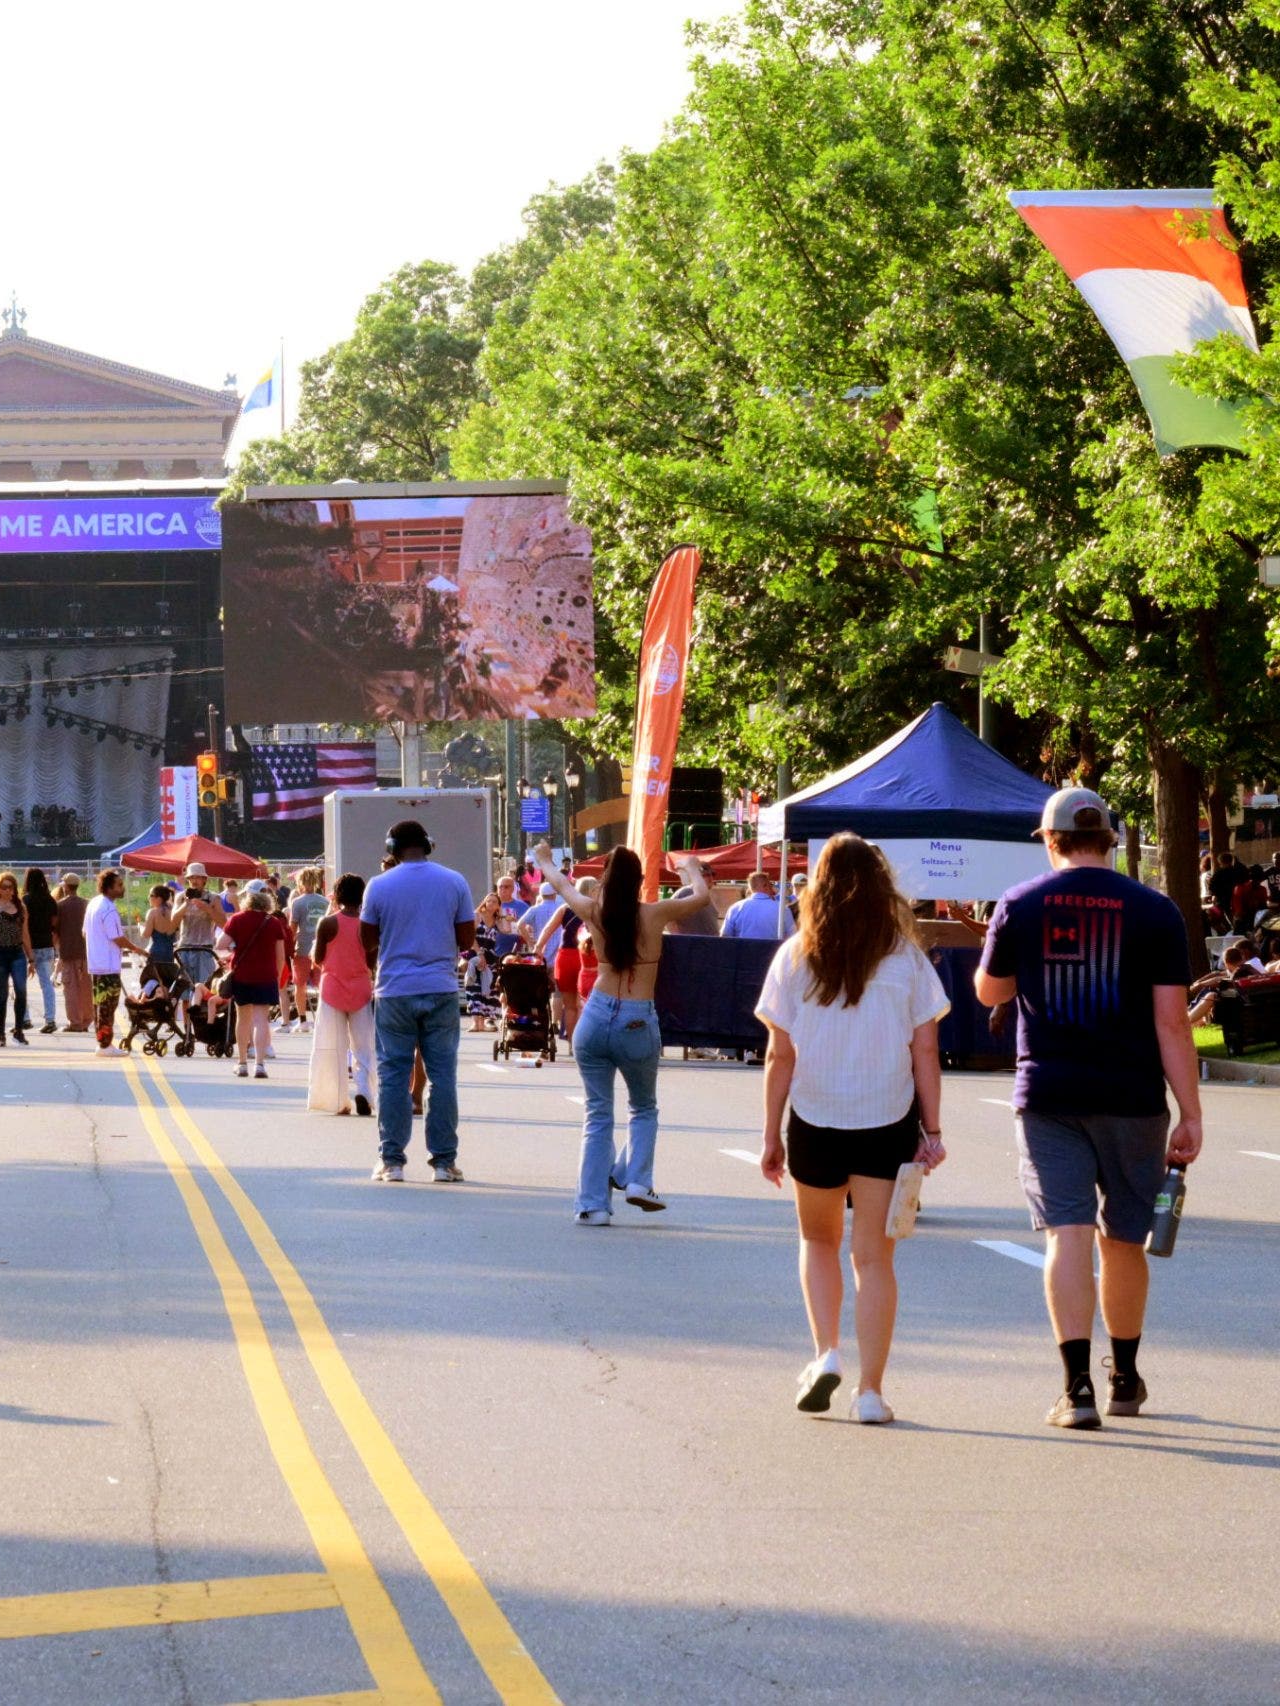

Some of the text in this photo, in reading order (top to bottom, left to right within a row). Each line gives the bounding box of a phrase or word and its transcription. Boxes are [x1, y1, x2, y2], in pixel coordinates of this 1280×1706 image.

[50, 512, 188, 536] AMERICA
[930, 841, 962, 851] Menu
[1044, 895, 1124, 910] FREEDOM
